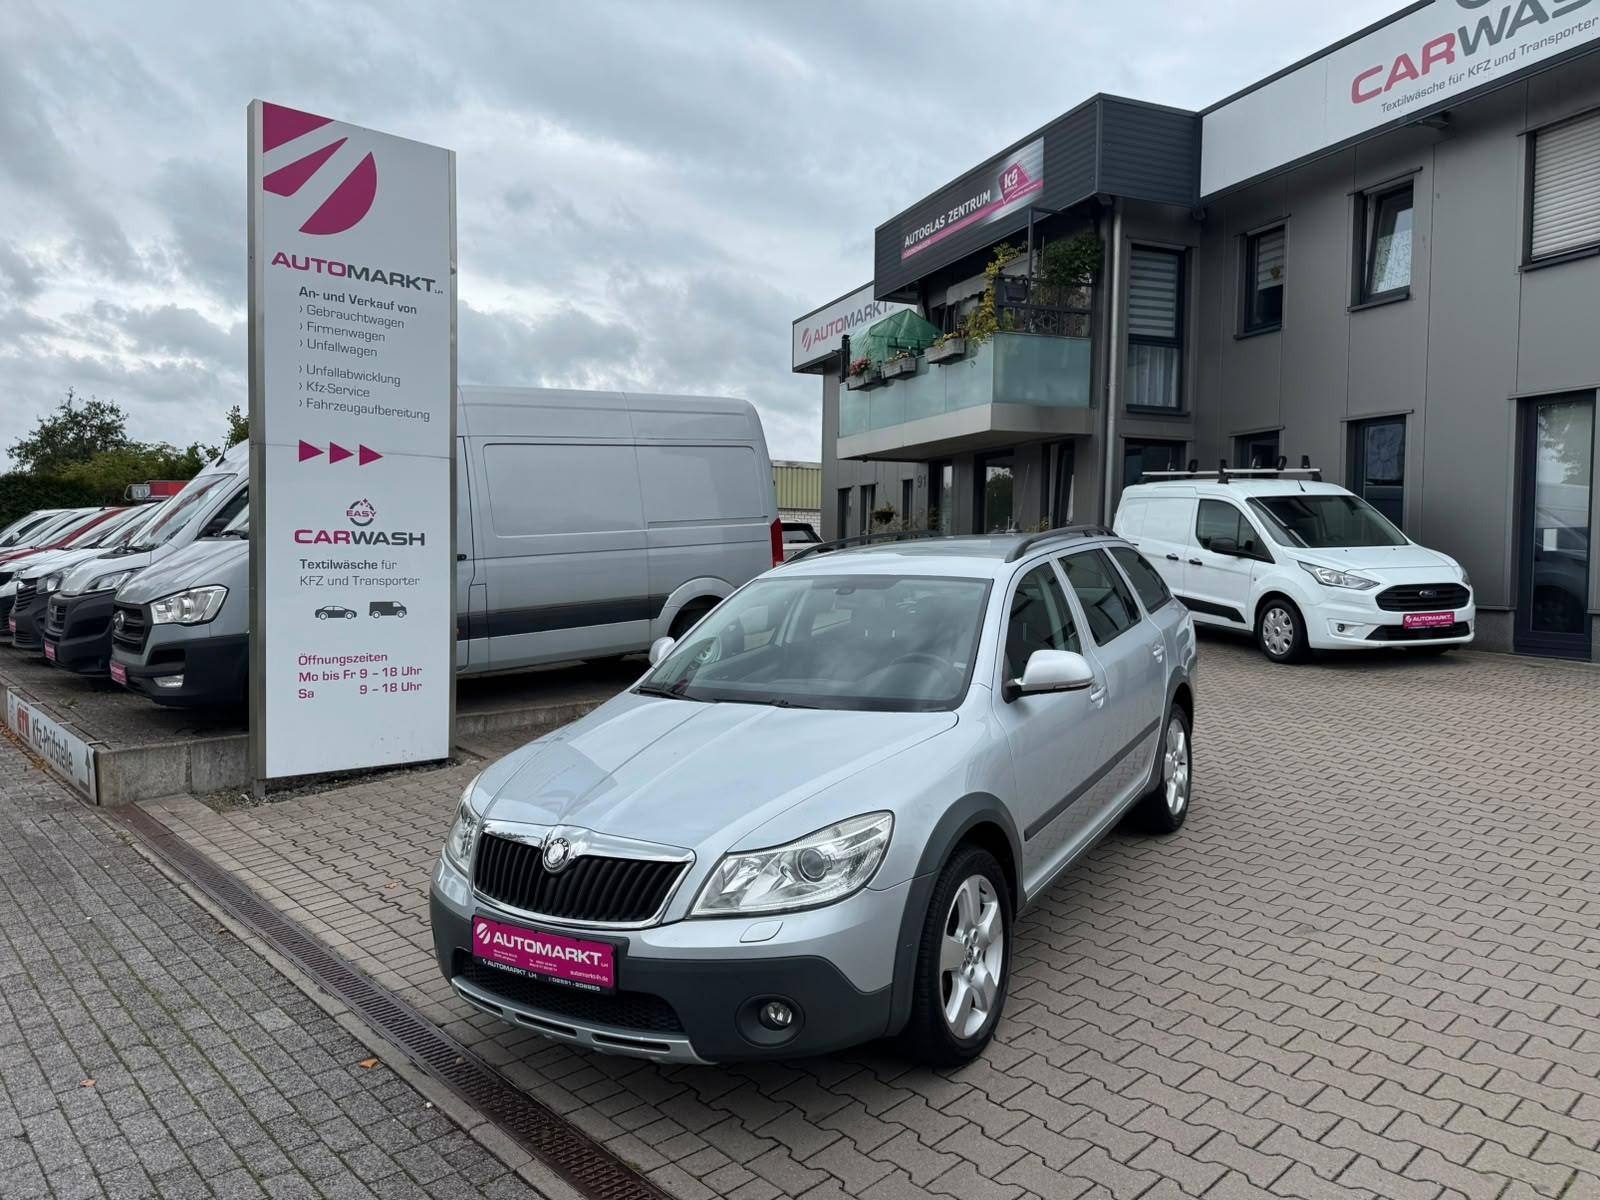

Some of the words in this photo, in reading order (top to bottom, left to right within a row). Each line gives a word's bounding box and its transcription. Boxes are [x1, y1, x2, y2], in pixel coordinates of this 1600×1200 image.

[1380, 80, 1446, 113] Textilwäsche
[1448, 71, 1465, 86] für
[1468, 59, 1491, 79] KFZ
[1494, 48, 1516, 67] und
[1519, 16, 1599, 56] Transporter
[904, 215, 945, 248] AUTOGLAS
[948, 189, 991, 224] ZENTRUM
[271, 251, 436, 292] AUTOMARKT
[299, 286, 320, 298] An-
[323, 292, 345, 303] und
[348, 294, 395, 311] Verkauf
[397, 304, 417, 314] von
[306, 304, 405, 329] Gebrauchtwagen
[813, 301, 887, 344] AUTOMARKT
[307, 321, 385, 342] Firmenwagen
[307, 338, 378, 358] Unfallwagen
[306, 364, 401, 387] Unfallabwicklung
[306, 381, 370, 398] Kfz-Service
[306, 398, 430, 422] Fahrzeugaufbereitung
[346, 509, 377, 518] EASY
[294, 529, 425, 546] CARWASH
[300, 558, 378, 570] Textilwäsche
[381, 560, 397, 570] für
[300, 575, 324, 586] KFZ
[327, 576, 349, 586] und
[352, 575, 420, 588] Transporter
[298, 652, 388, 666] Öffnungszeiten
[298, 671, 319, 682] Mo
[322, 670, 340, 681] bis
[343, 669, 356, 680] Fr
[359, 668, 368, 679] 9
[382, 666, 398, 677] 18
[401, 666, 422, 676] Uhr
[298, 689, 315, 699] Sa
[359, 685, 368, 695] 9
[382, 682, 398, 693] 18
[401, 681, 422, 692] Uhr
[32, 717, 73, 776] Kfz-Prüfstelle
[493, 931, 602, 966] AUTOMARKT
[487, 960, 526, 976] AUTOMARKT
